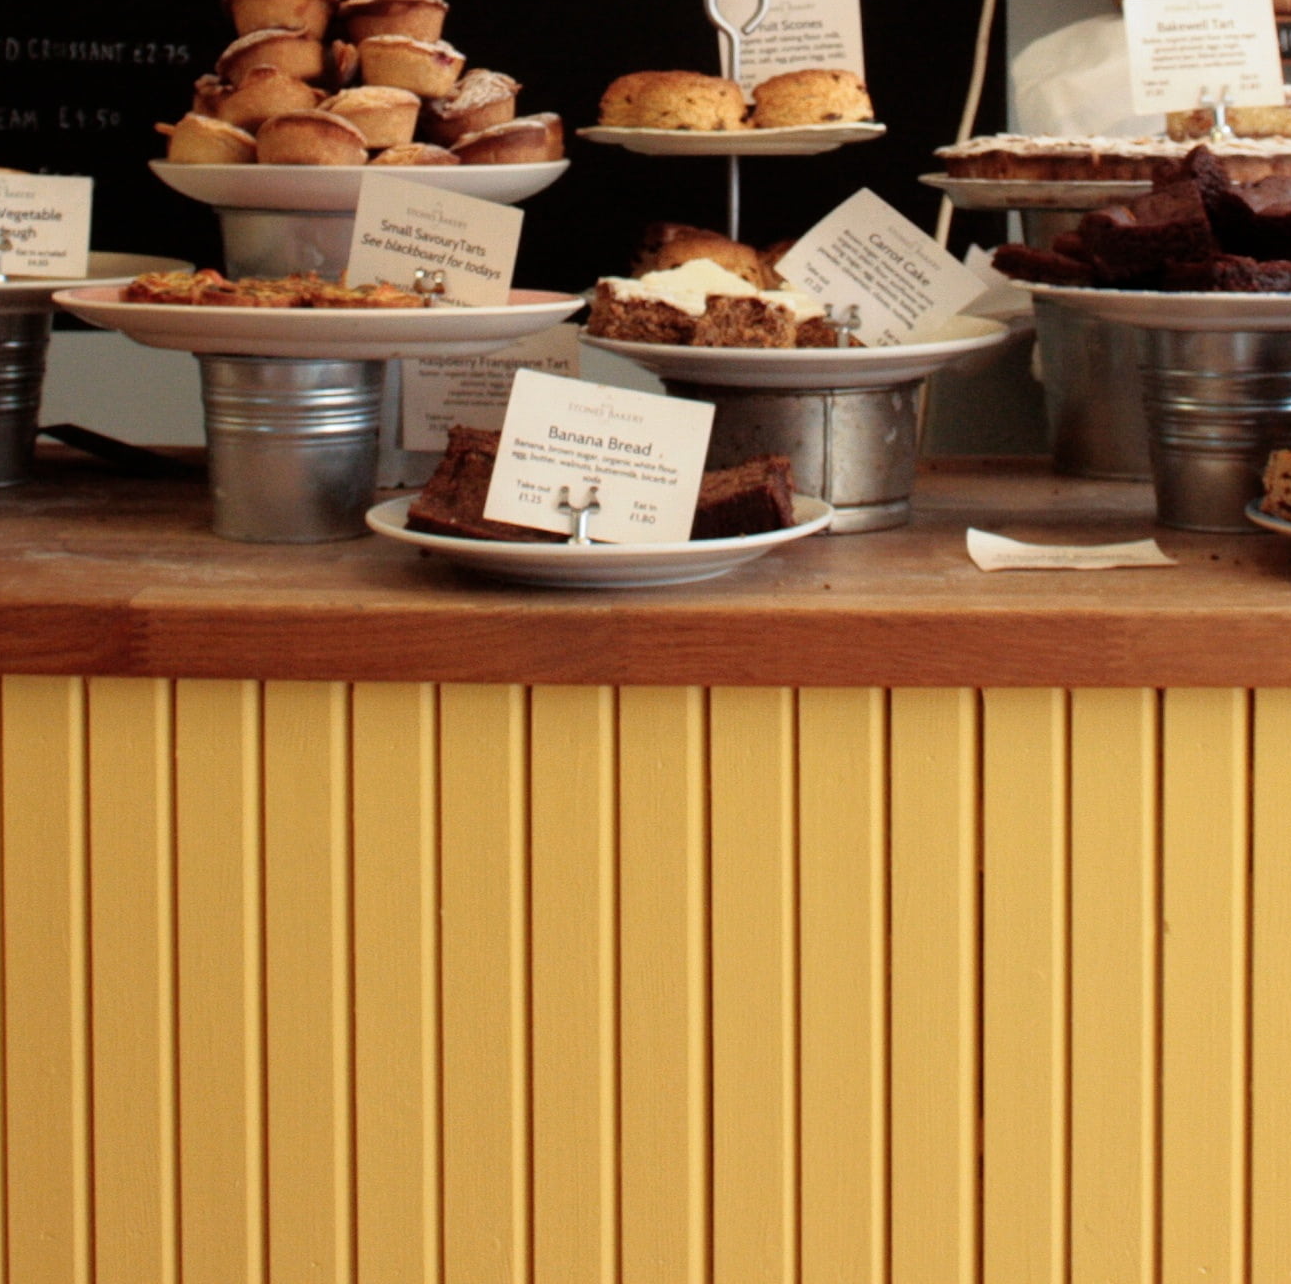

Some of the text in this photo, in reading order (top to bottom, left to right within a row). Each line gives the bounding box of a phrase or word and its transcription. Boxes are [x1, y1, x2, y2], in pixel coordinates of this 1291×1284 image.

[782, 19, 823, 31] Scones
[1157, 18, 1235, 33] Bakewell Tart
[380, 219, 487, 258] Small Savoury Tarts
[361, 233, 382, 248] See
[384, 238, 446, 265] blackboard
[445, 253, 465, 271] for
[464, 260, 502, 281] todays
[867, 232, 932, 288] Carrot Cake
[548, 424, 653, 458] Banana Bread
[516, 478, 551, 494] Take out
[633, 499, 648, 512] Eat
